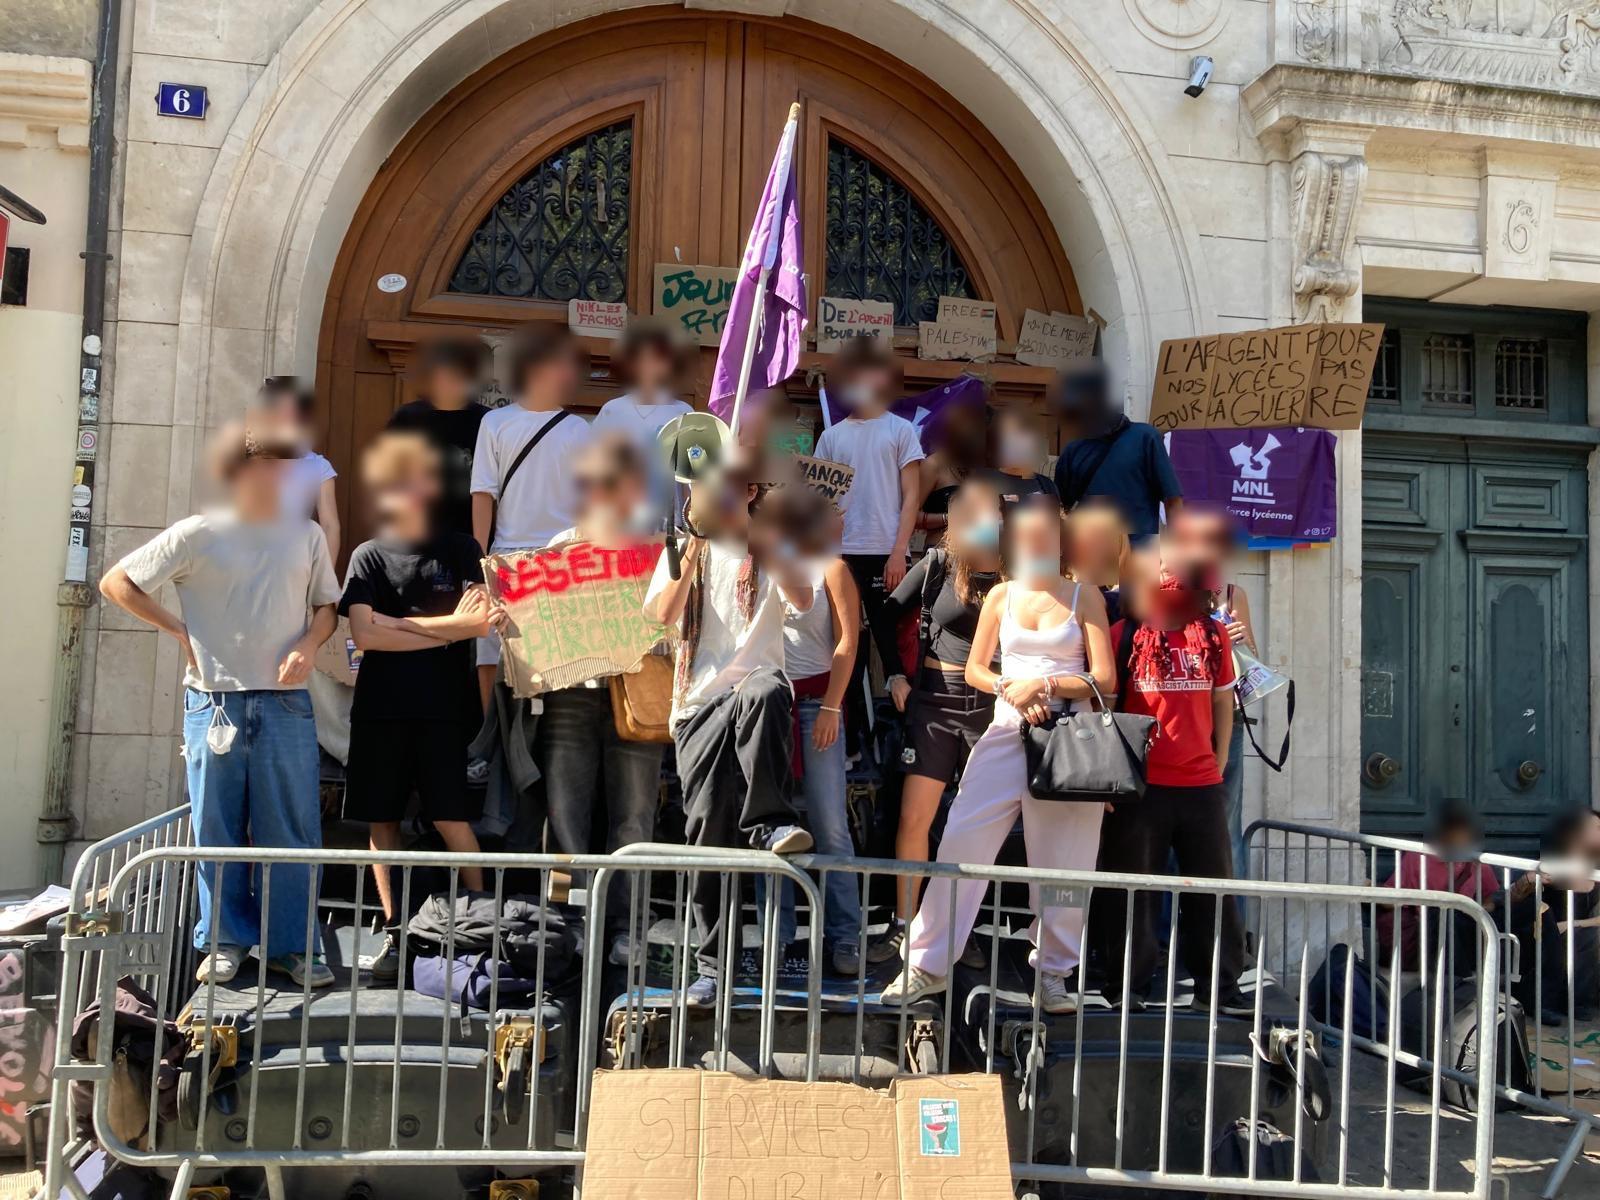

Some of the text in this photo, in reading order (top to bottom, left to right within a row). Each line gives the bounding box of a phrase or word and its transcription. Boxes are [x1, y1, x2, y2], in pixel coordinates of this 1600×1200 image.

[173, 88, 191, 114] 6
[578, 313, 625, 328] FACHOS
[943, 304, 980, 317] FREE
[823, 325, 854, 340] POUR
[1162, 327, 1376, 376] L'ARGENT POUR
[1167, 357, 1366, 398] NOS LYCÉES PAS
[1152, 383, 1363, 428] POUR LA GUERRE
[798, 460, 853, 489] MANQUE
[1231, 480, 1275, 497] MNL
[1252, 509, 1294, 521] lycéenne
[632, 1092, 871, 1162] SERVICES
